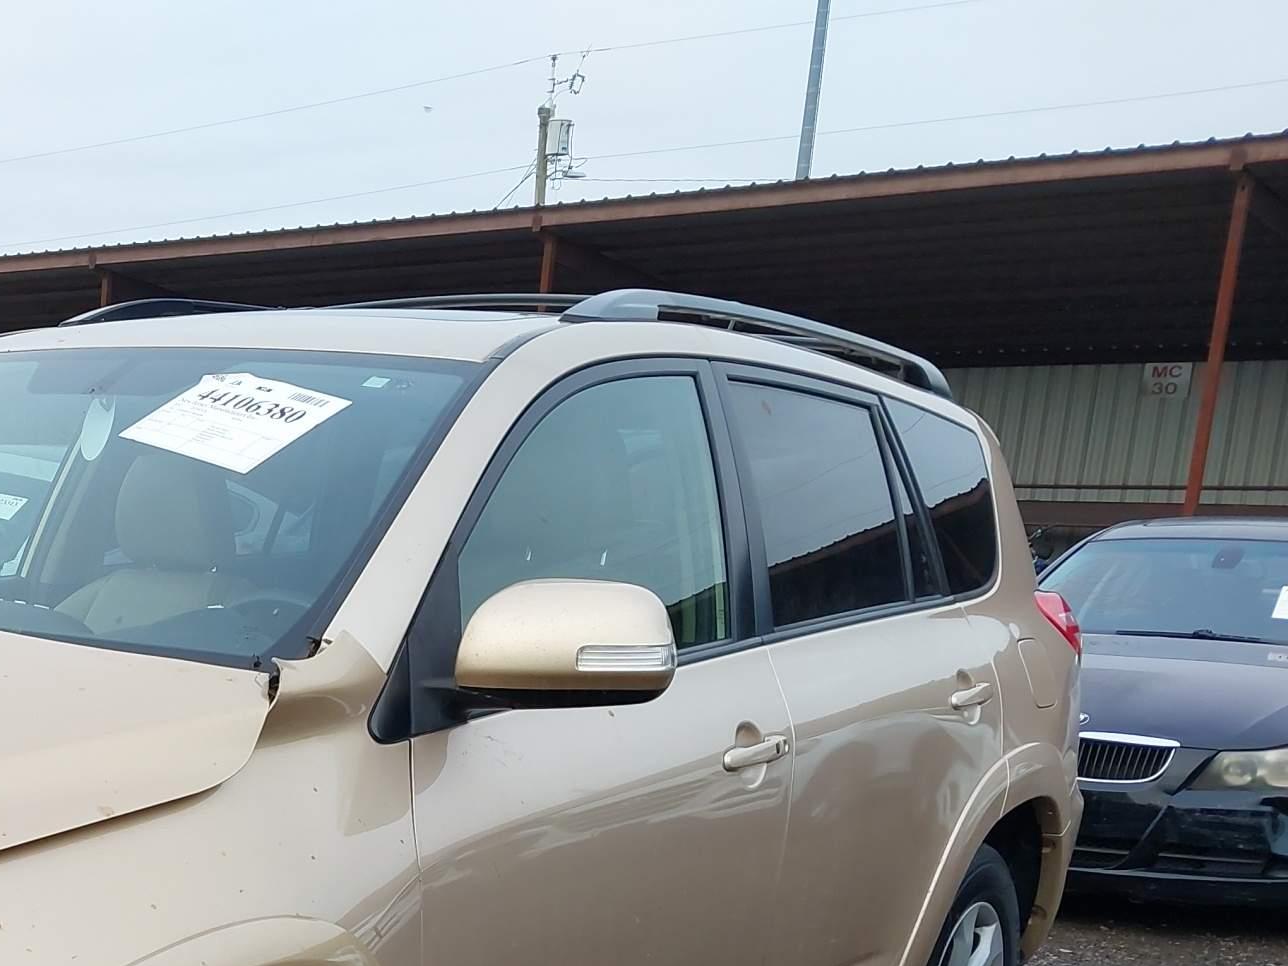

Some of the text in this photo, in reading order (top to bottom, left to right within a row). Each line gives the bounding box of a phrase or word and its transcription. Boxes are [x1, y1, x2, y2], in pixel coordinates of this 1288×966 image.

[1151, 365, 1183, 378] MC
[1151, 382, 1178, 395] 30
[197, 389, 307, 424] 44106380
